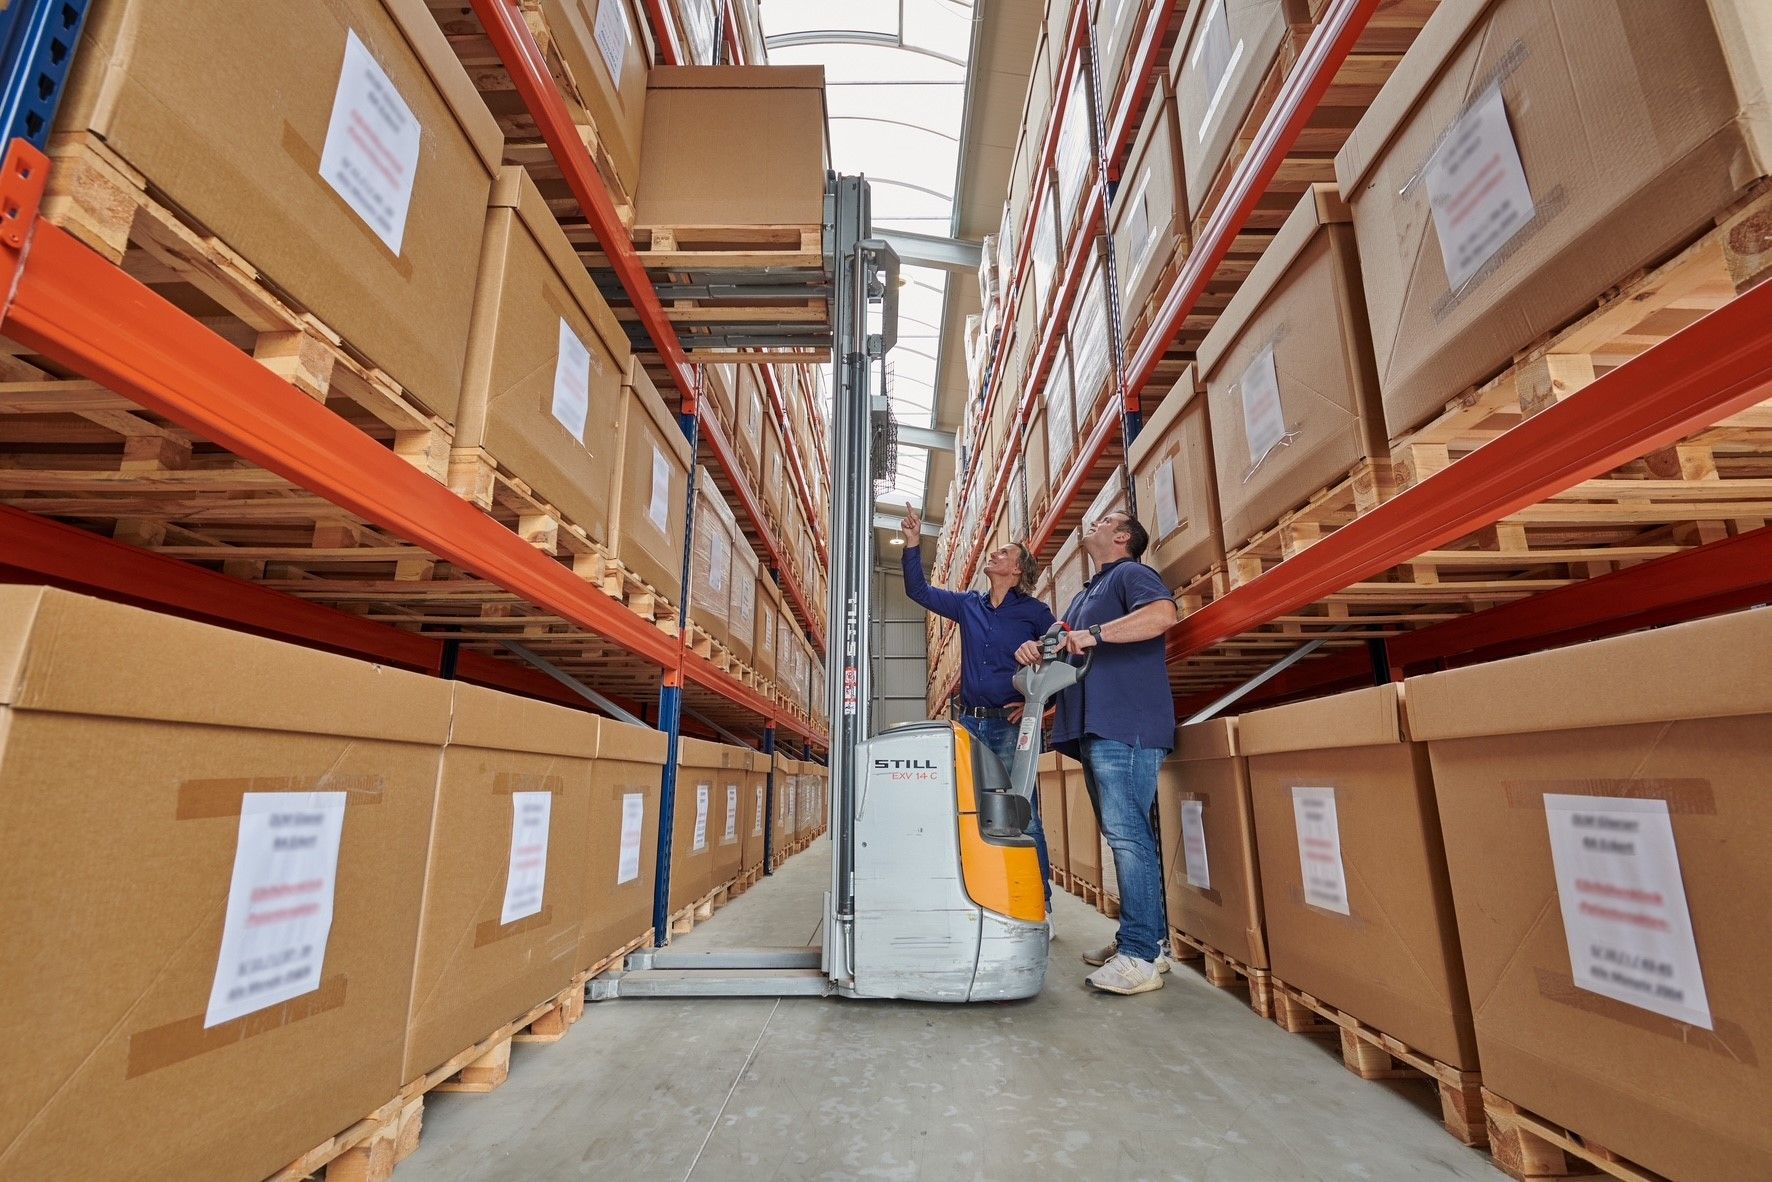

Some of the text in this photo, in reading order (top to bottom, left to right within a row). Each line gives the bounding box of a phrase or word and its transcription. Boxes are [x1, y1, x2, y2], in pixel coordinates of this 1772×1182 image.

[847, 591, 857, 657] STILL
[874, 759, 937, 769] STILL
[892, 772, 938, 780] EXV 14 C
